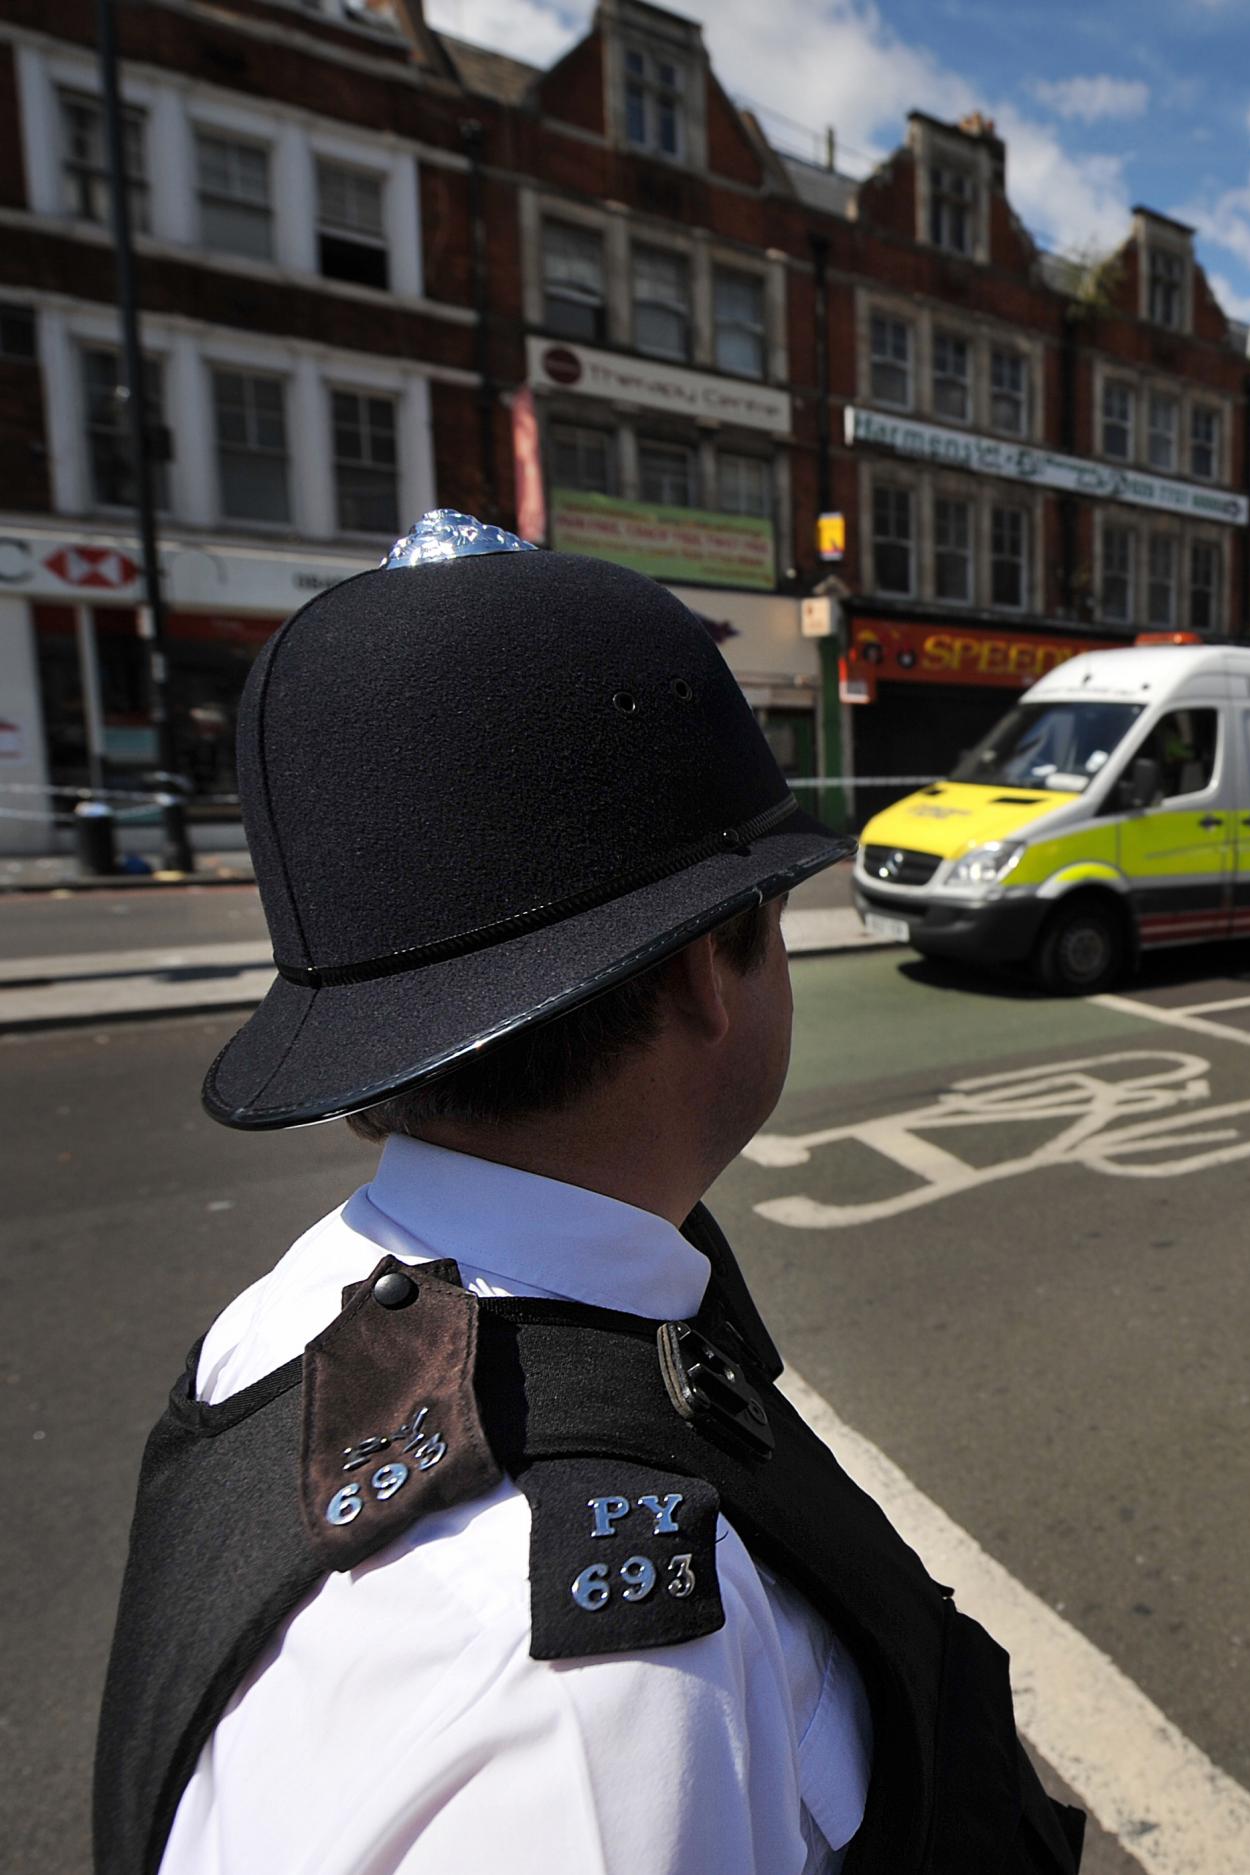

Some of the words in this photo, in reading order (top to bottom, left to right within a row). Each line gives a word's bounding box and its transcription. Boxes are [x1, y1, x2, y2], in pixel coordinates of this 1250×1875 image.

[589, 363, 697, 405] Therapy
[326, 1432, 448, 1526] 693
[587, 1493, 683, 1539] PY
[571, 1553, 696, 1612] 693
